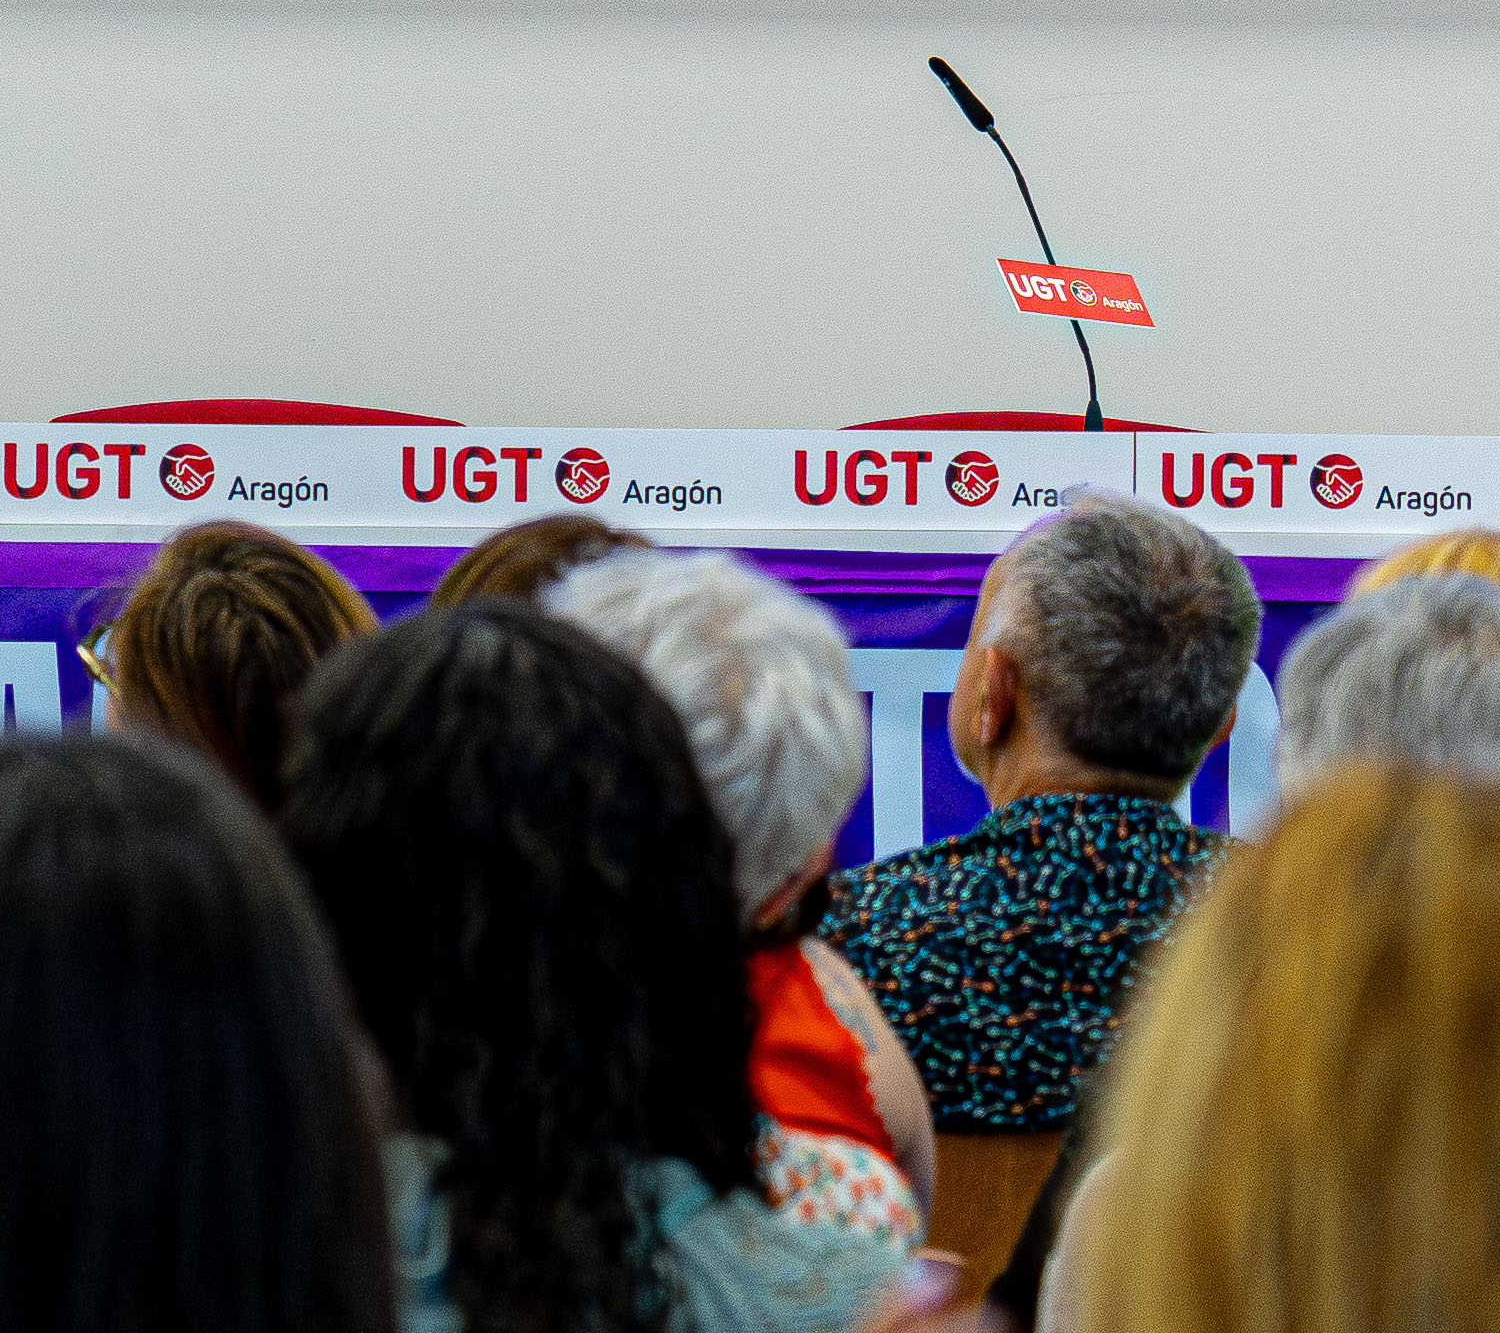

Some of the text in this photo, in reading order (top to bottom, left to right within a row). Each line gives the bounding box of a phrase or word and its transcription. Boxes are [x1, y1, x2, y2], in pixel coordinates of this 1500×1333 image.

[1007, 272, 1144, 313] UGT Aragón
[3, 442, 329, 509] UGT Aragón
[402, 446, 722, 512] UGT Aragón
[794, 450, 933, 506] UGT
[1161, 452, 1472, 517] UGT Aragón
